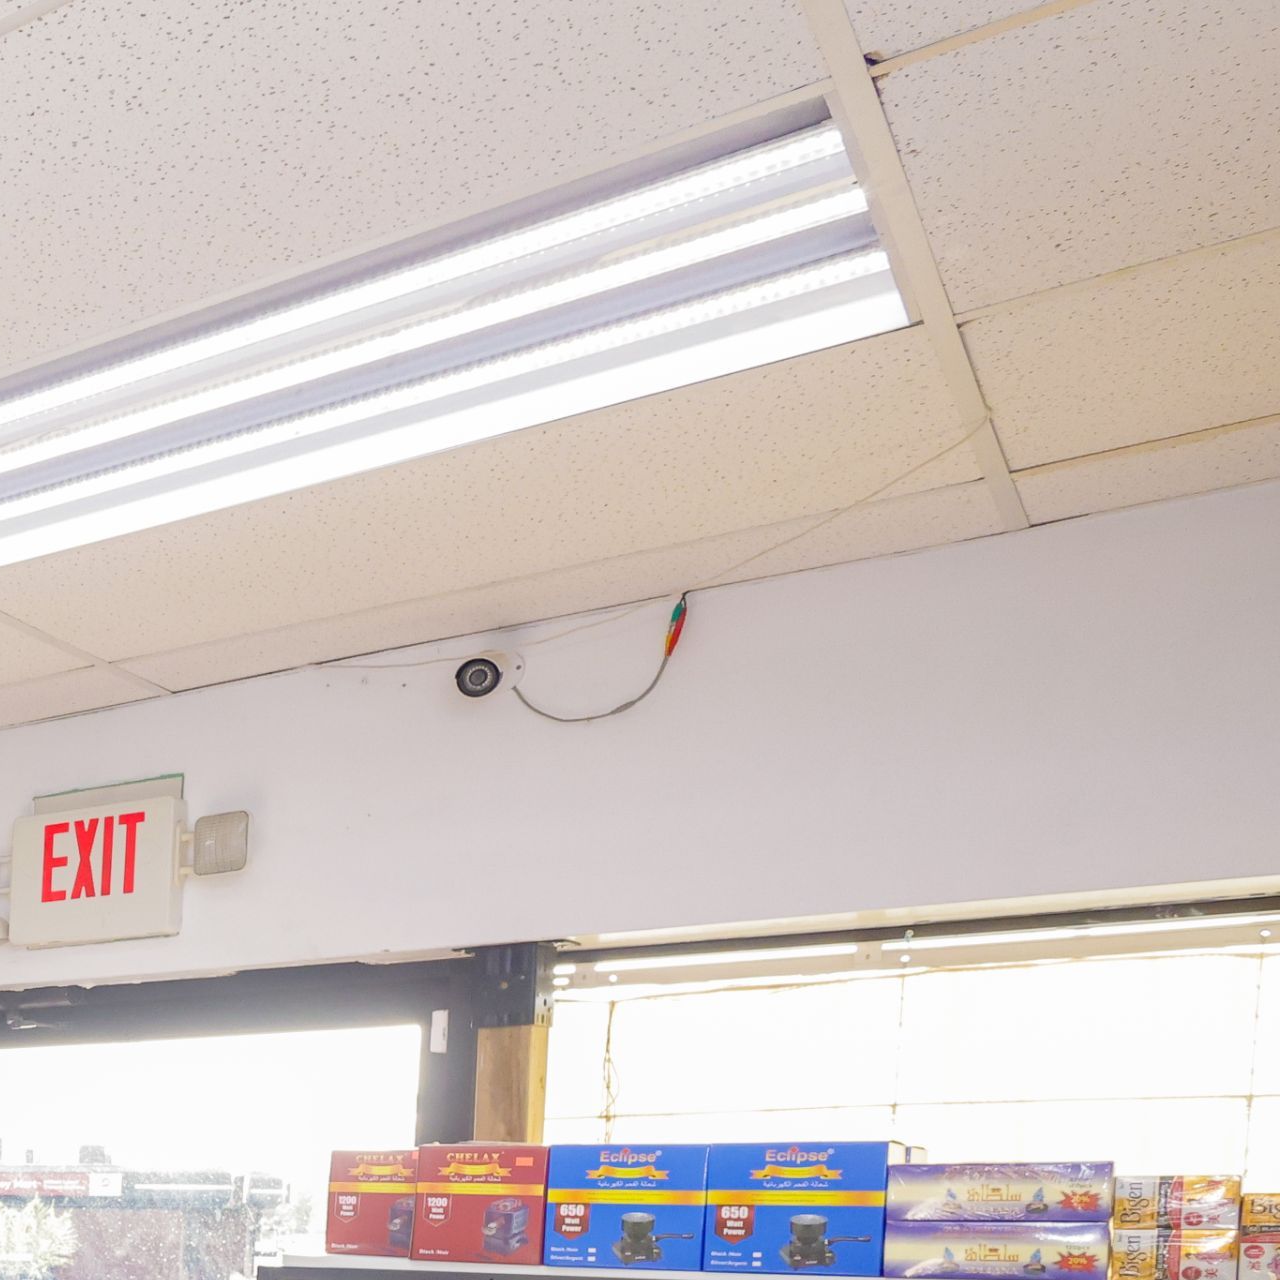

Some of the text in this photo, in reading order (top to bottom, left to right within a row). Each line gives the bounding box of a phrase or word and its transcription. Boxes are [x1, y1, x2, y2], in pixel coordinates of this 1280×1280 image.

[41, 811, 144, 902] EXIT
[447, 1152, 500, 1162] CHELAX
[600, 1149, 657, 1163] Eclipse
[765, 1148, 829, 1162] Eclipse
[339, 1195, 357, 1205] 1200
[427, 1197, 448, 1207] 1200
[1121, 1181, 1144, 1225] Bigen
[560, 1204, 584, 1217] 650
[721, 1205, 748, 1219] 650
[1119, 1235, 1142, 1278] Bigen
